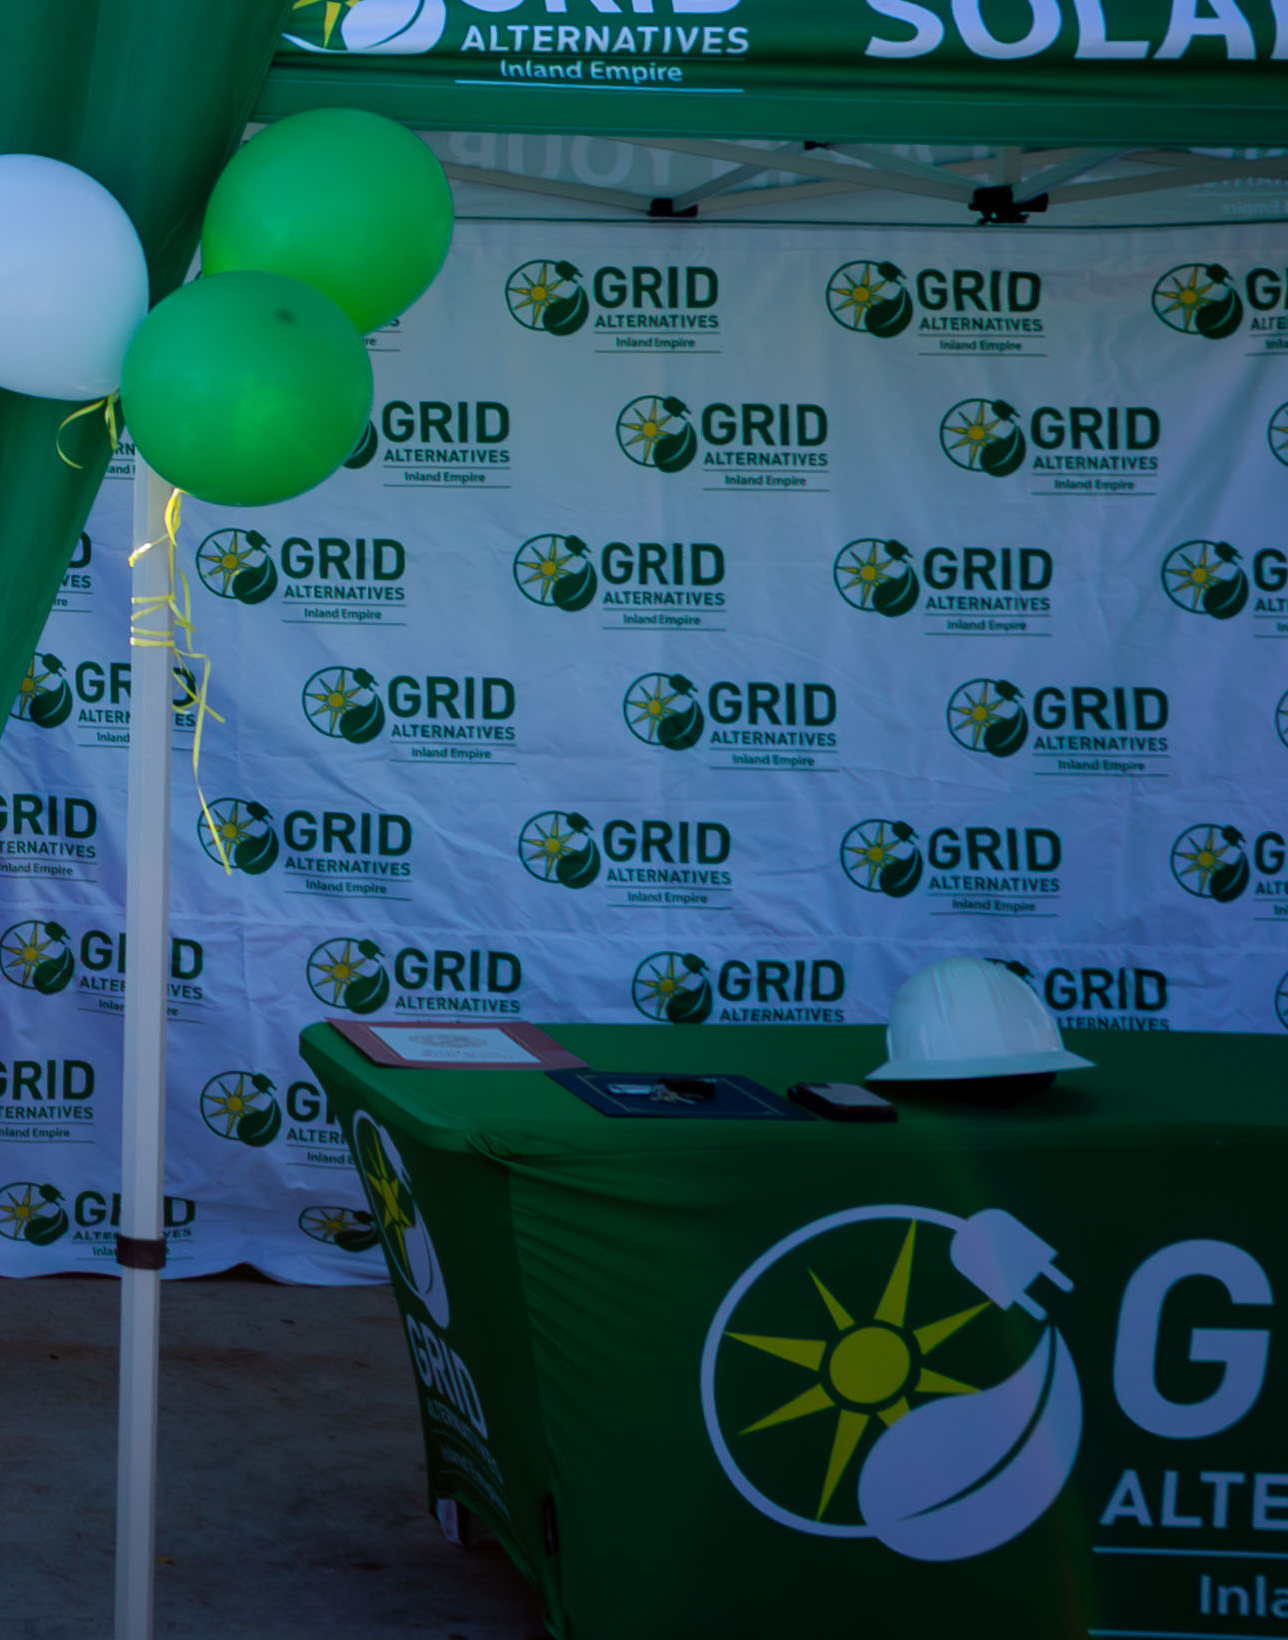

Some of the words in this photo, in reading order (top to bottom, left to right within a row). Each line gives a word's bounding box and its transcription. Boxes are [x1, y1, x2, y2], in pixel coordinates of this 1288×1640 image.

[461, 25, 750, 54] ALTERNATIVES
[500, 59, 585, 80] Inland
[589, 61, 684, 84] Empire
[593, 266, 718, 309] GRID
[916, 268, 1041, 312] GRID
[594, 314, 719, 328] ALTERNATIVES
[918, 317, 1043, 332] ALTERNATIVES
[616, 337, 653, 348] Inland
[655, 338, 696, 348] Empire
[939, 340, 977, 351] Inland
[979, 340, 1023, 352] Empire
[382, 400, 509, 444] GRID
[701, 402, 828, 446] GRID
[1030, 406, 1160, 450] GRID
[383, 449, 510, 463] ALTERNATIVES
[703, 452, 828, 466] ALTERNATIVES
[1031, 456, 1158, 470] ALTERNATIVES
[404, 472, 441, 482] Inland
[443, 472, 486, 483] Empire
[725, 475, 763, 485] Inland
[765, 475, 807, 487] Empire
[1054, 479, 1093, 490] Inland
[1093, 479, 1135, 491] Empire
[281, 537, 405, 581] GRID
[601, 542, 725, 586] GRID
[923, 547, 1053, 591] GRID
[284, 585, 405, 600] ALTERNATIVES
[602, 591, 725, 606] ALTERNATIVES
[925, 596, 1051, 611] ALTERNATIVES
[304, 608, 339, 618] Inland
[341, 609, 382, 620] Empire
[623, 614, 657, 624] Inland
[658, 614, 701, 626] Empire
[947, 620, 984, 631] Inland
[986, 621, 1027, 631] Empire
[75, 660, 198, 707] GRD
[388, 675, 515, 720] GRID
[708, 681, 837, 726] GRID
[1033, 686, 1169, 731] GRID
[391, 724, 515, 740] ALTERNATIVES
[709, 731, 837, 746] ALTERNATIVES
[1033, 736, 1168, 751] ALTERNATIVES
[411, 747, 449, 758] Inland
[449, 748, 492, 759] Empire
[732, 754, 771, 765] Inland
[771, 754, 815, 767] Empire
[1057, 759, 1097, 771] Inland
[1103, 760, 1145, 772] Empire
[283, 810, 413, 856] GRID
[603, 820, 731, 864] GRID
[927, 827, 1062, 873] GRID
[33, 863, 73, 875] Empire
[285, 857, 411, 876] ALTERNATIVES
[607, 867, 731, 885] ALTERNATIVES
[929, 875, 1060, 892] ALTERNATIVES
[305, 879, 343, 892] Inland
[345, 882, 387, 894] Empire
[627, 891, 663, 902] Inland
[664, 892, 709, 904] Empire
[951, 898, 991, 912] Inland
[993, 899, 1036, 912] Empire
[394, 947, 522, 994] GRID
[717, 960, 845, 1003] GRID
[1044, 967, 1168, 1011] GRID
[395, 996, 521, 1013] ALTERNATIVES
[720, 1008, 844, 1021] ALTERNATIVES
[1057, 1016, 1169, 1031] LTERNATIVES
[32, 1128, 71, 1138] Empire
[407, 1313, 489, 1440] GRID
[1199, 1573, 1288, 1620] Inla
